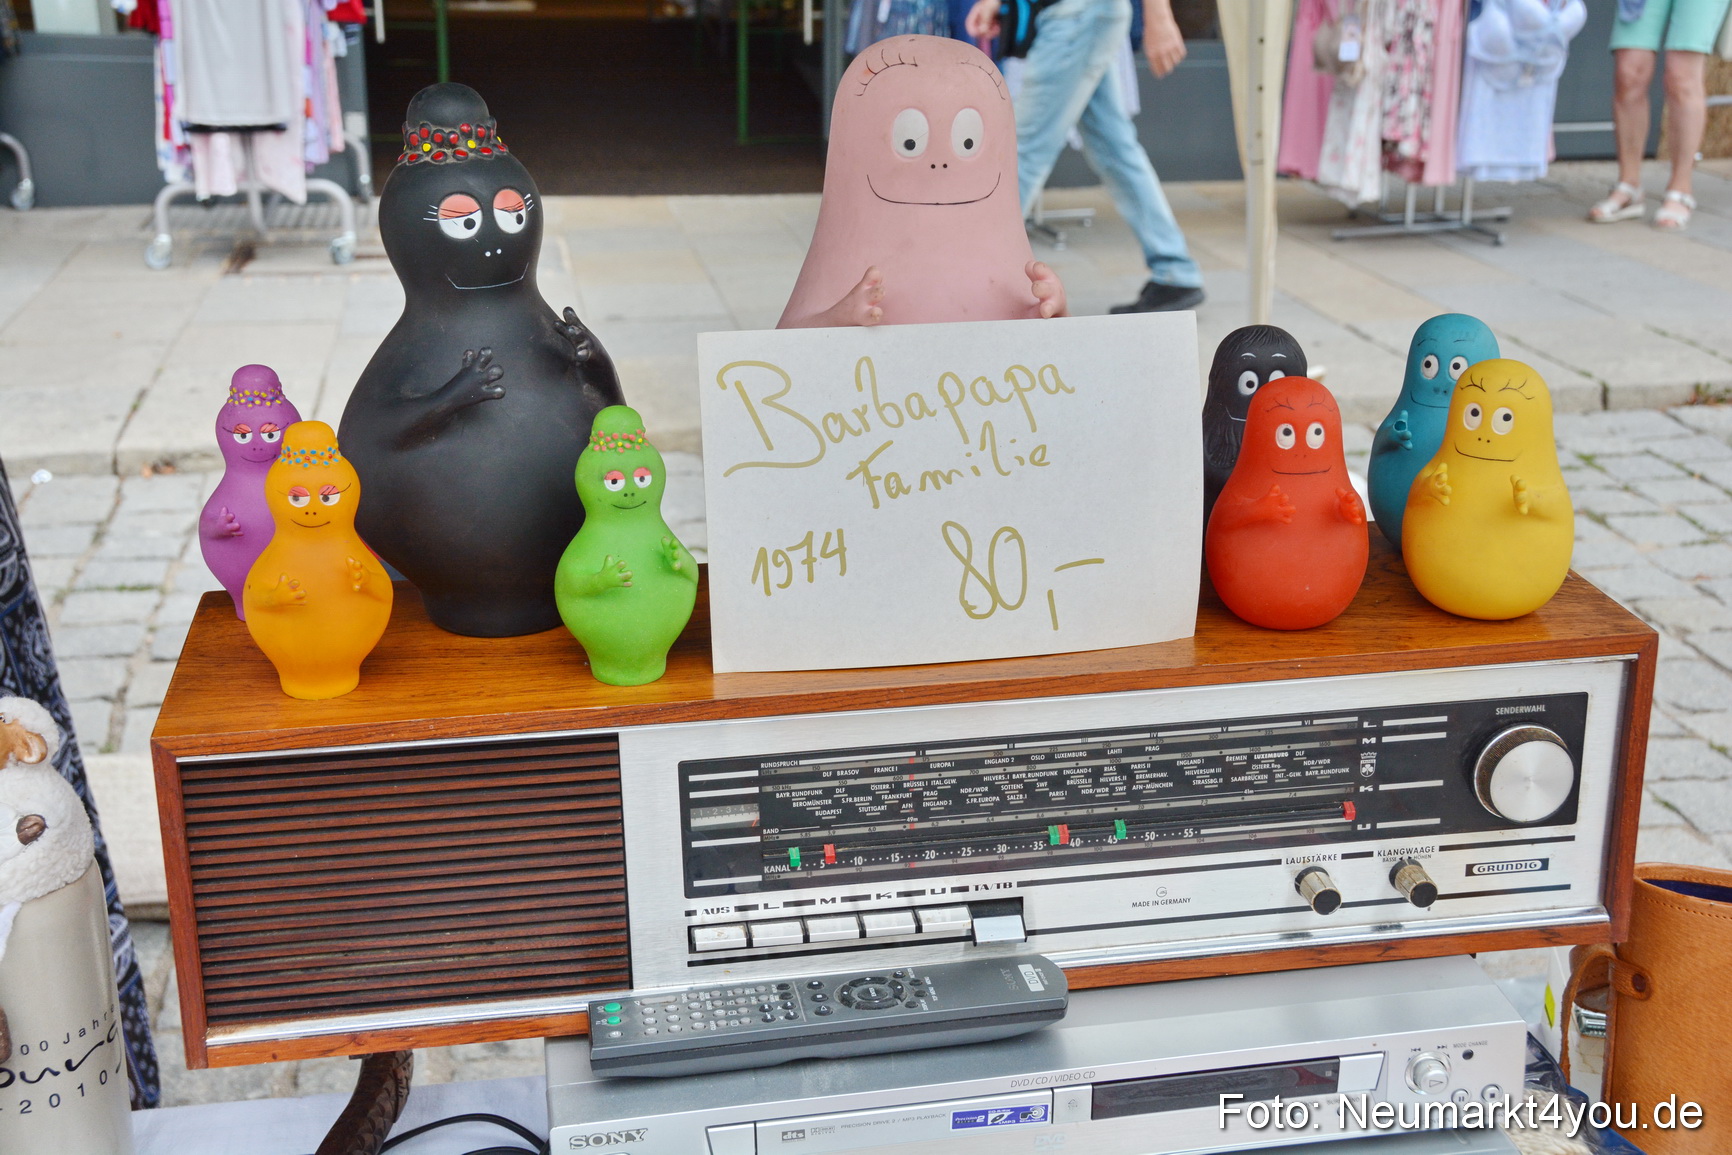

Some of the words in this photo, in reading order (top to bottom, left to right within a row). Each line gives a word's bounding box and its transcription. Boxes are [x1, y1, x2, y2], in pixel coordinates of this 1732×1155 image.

[716, 356, 1075, 477] Barbapapa
[846, 420, 1050, 509] Familie
[751, 528, 847, 597] 1974
[1496, 704, 1546, 715] SENDERWAHL
[760, 760, 798, 769] RUNDSPRUCH
[1231, 774, 1268, 782] SAARBRÜCKEN
[793, 799, 832, 808] BEROMÜNSTER
[764, 864, 790, 873] KANAL
[820, 860, 825, 868] 5
[854, 856, 863, 865] 10
[891, 853, 900, 862] 15
[925, 850, 936, 859] 20
[961, 847, 972, 856] 25
[996, 844, 1007, 853] 30
[1033, 841, 1044, 850] 35
[1070, 838, 1081, 847] 40
[1107, 835, 1117, 844] 45
[1144, 832, 1155, 841] 50
[1183, 828, 1194, 838] 55
[1378, 846, 1435, 857] KLANGWAAGE
[1286, 854, 1337, 864] LAUTSTÄRKE
[1478, 862, 1537, 873] GRUNDIG
[701, 906, 730, 915] AUS
[876, 892, 892, 900] K
[973, 882, 1012, 891] TA/TB
[1024, 970, 1039, 984] DVD
[63, 1004, 114, 1044] Jahre
[1083, 1071, 1096, 1079] CD
[570, 1128, 648, 1149] SONY
[782, 1131, 804, 1140] dts
